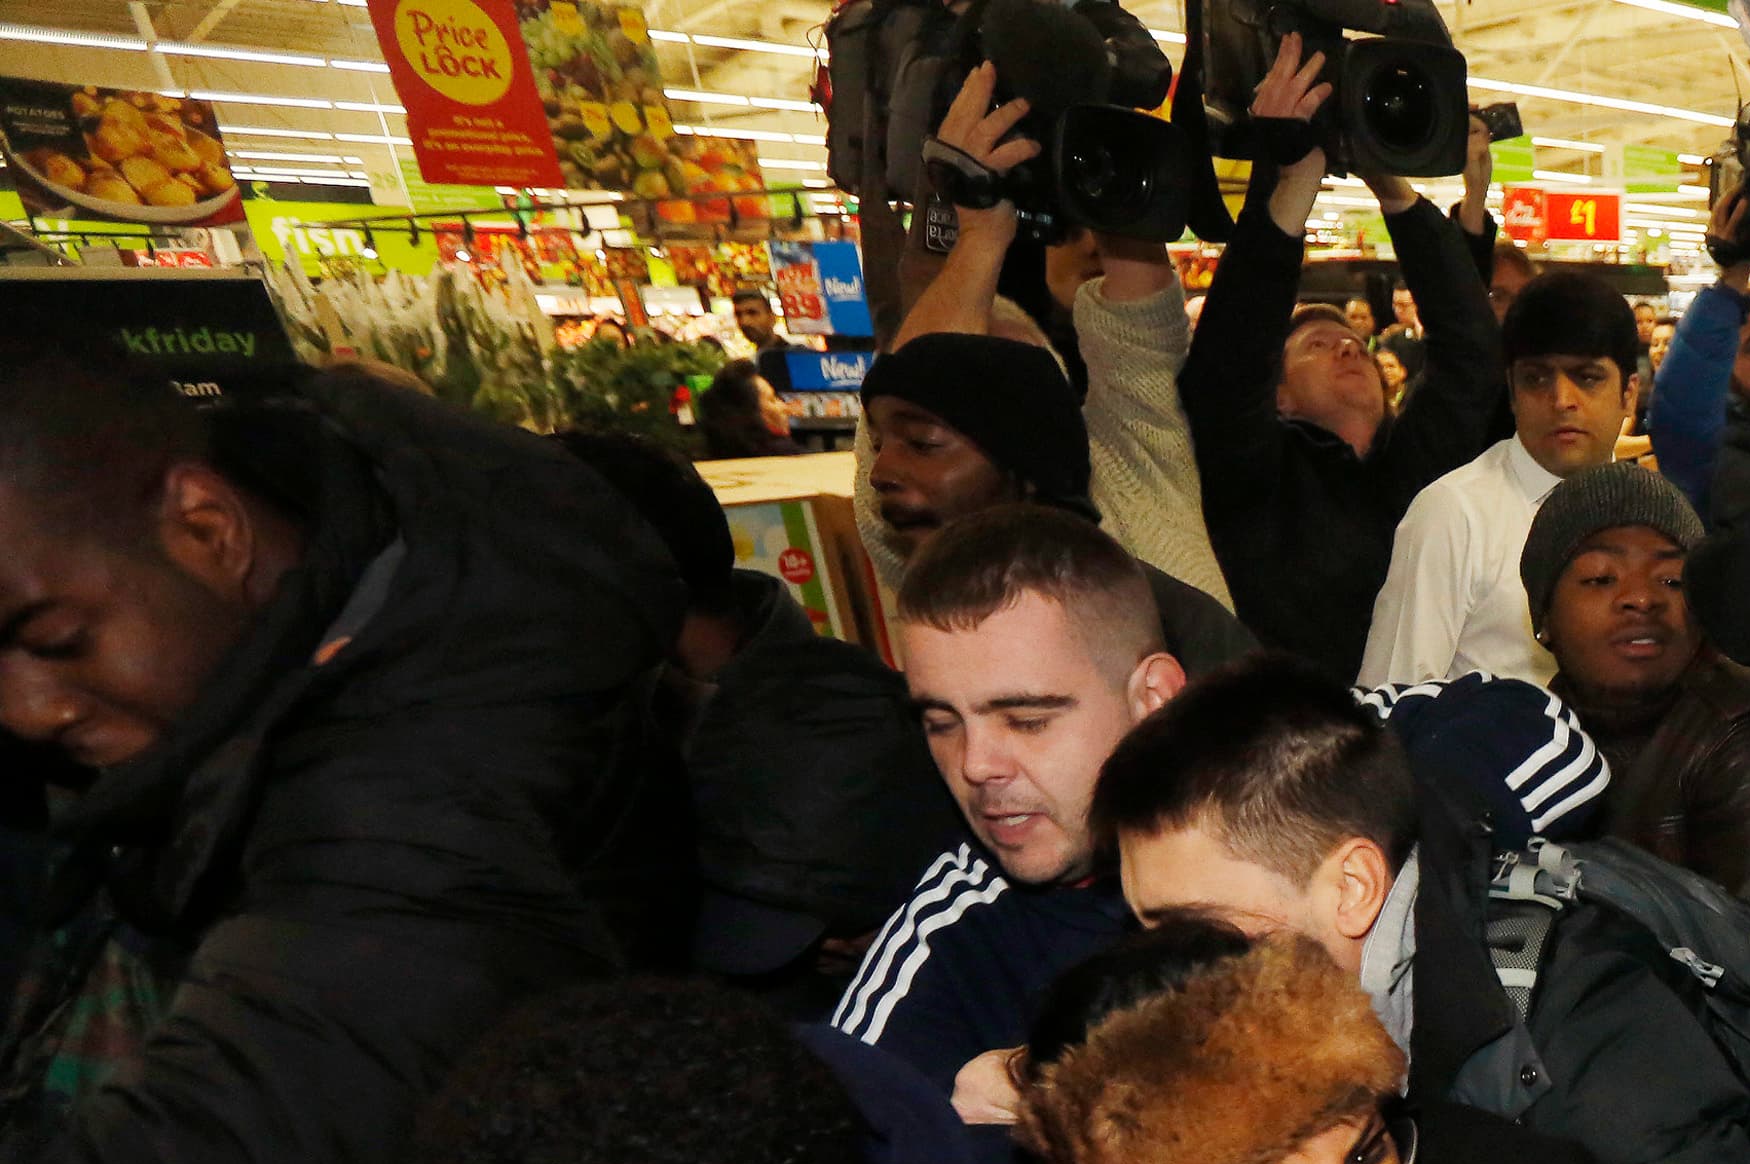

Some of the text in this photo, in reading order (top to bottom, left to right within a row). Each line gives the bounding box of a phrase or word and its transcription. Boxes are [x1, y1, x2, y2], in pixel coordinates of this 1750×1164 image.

[406, 10, 488, 50] Price
[420, 45, 502, 80] LOCK
[1569, 199, 1597, 236] £1
[824, 276, 862, 300] New!
[820, 353, 867, 384] New!
